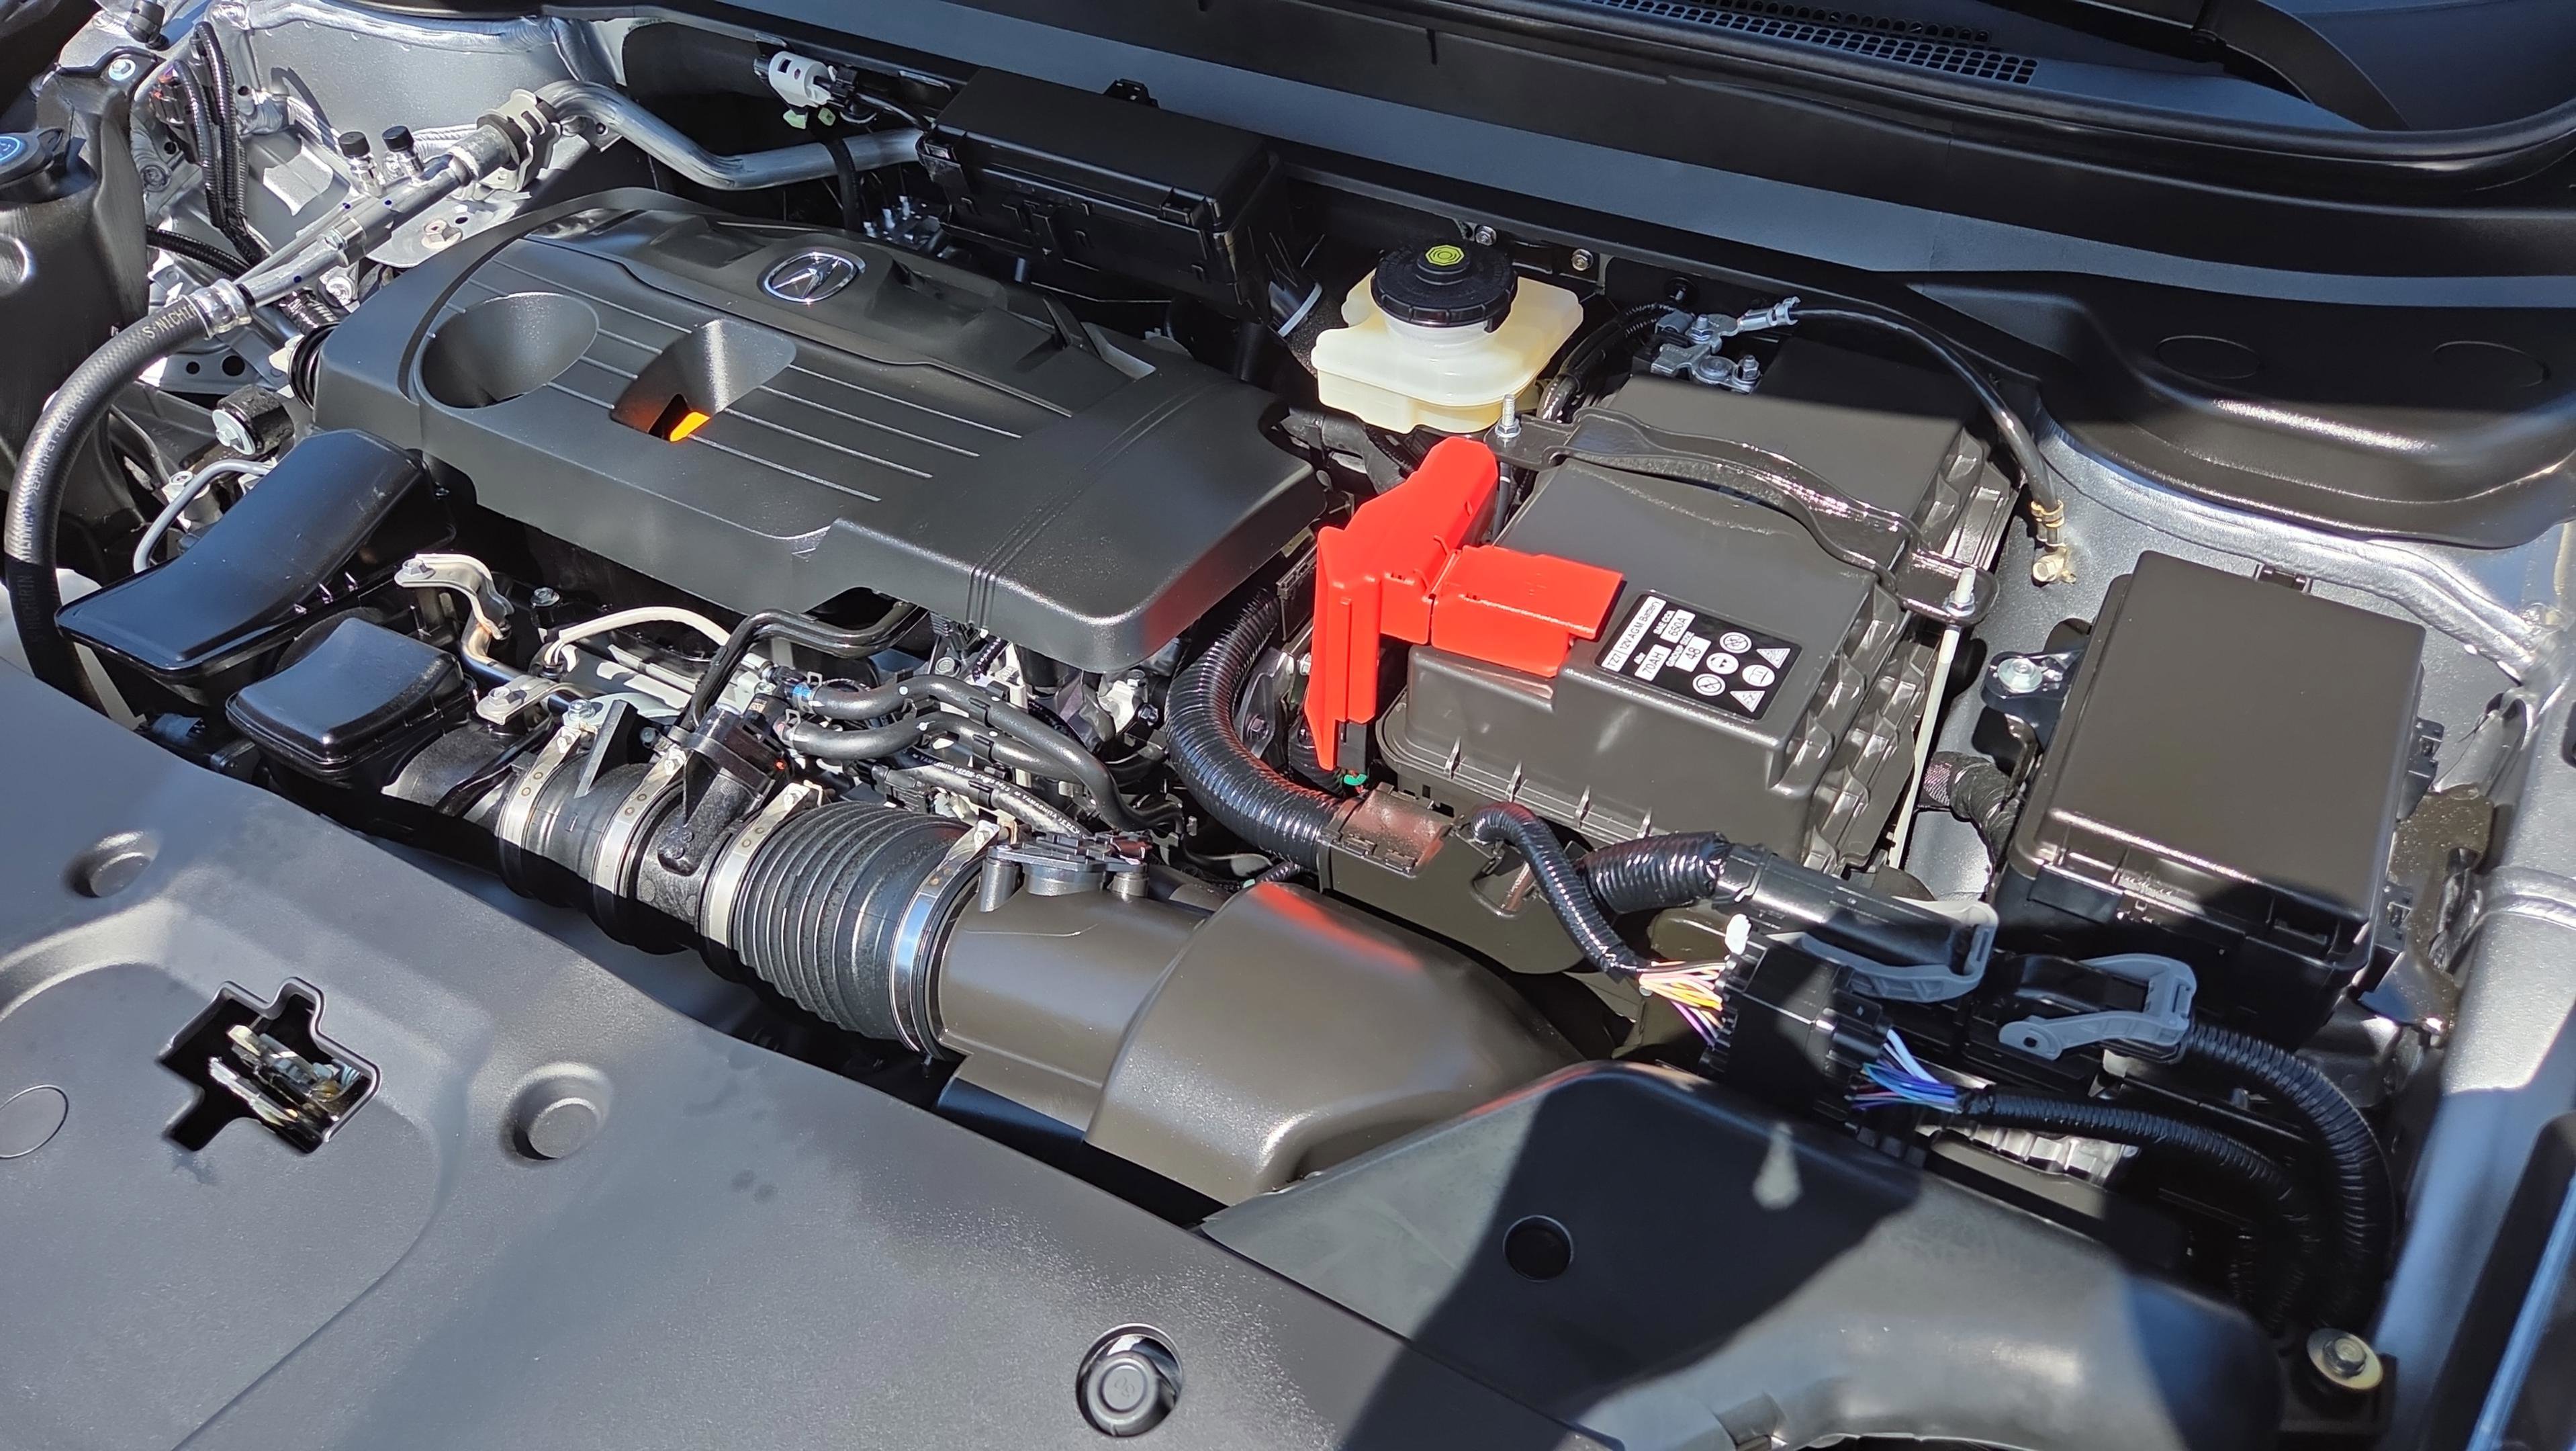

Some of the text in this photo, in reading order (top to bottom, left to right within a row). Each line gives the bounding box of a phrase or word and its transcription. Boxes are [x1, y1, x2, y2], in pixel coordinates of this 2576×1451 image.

[1607, 653, 1621, 666] TZ7
[1619, 637, 1632, 650] 12V
[1628, 622, 1644, 639] AGM
[1639, 601, 1661, 622] Battery
[1668, 617, 1688, 636] 650A
[1642, 652, 1665, 674] 70AH
[1685, 647, 1702, 660] 48
